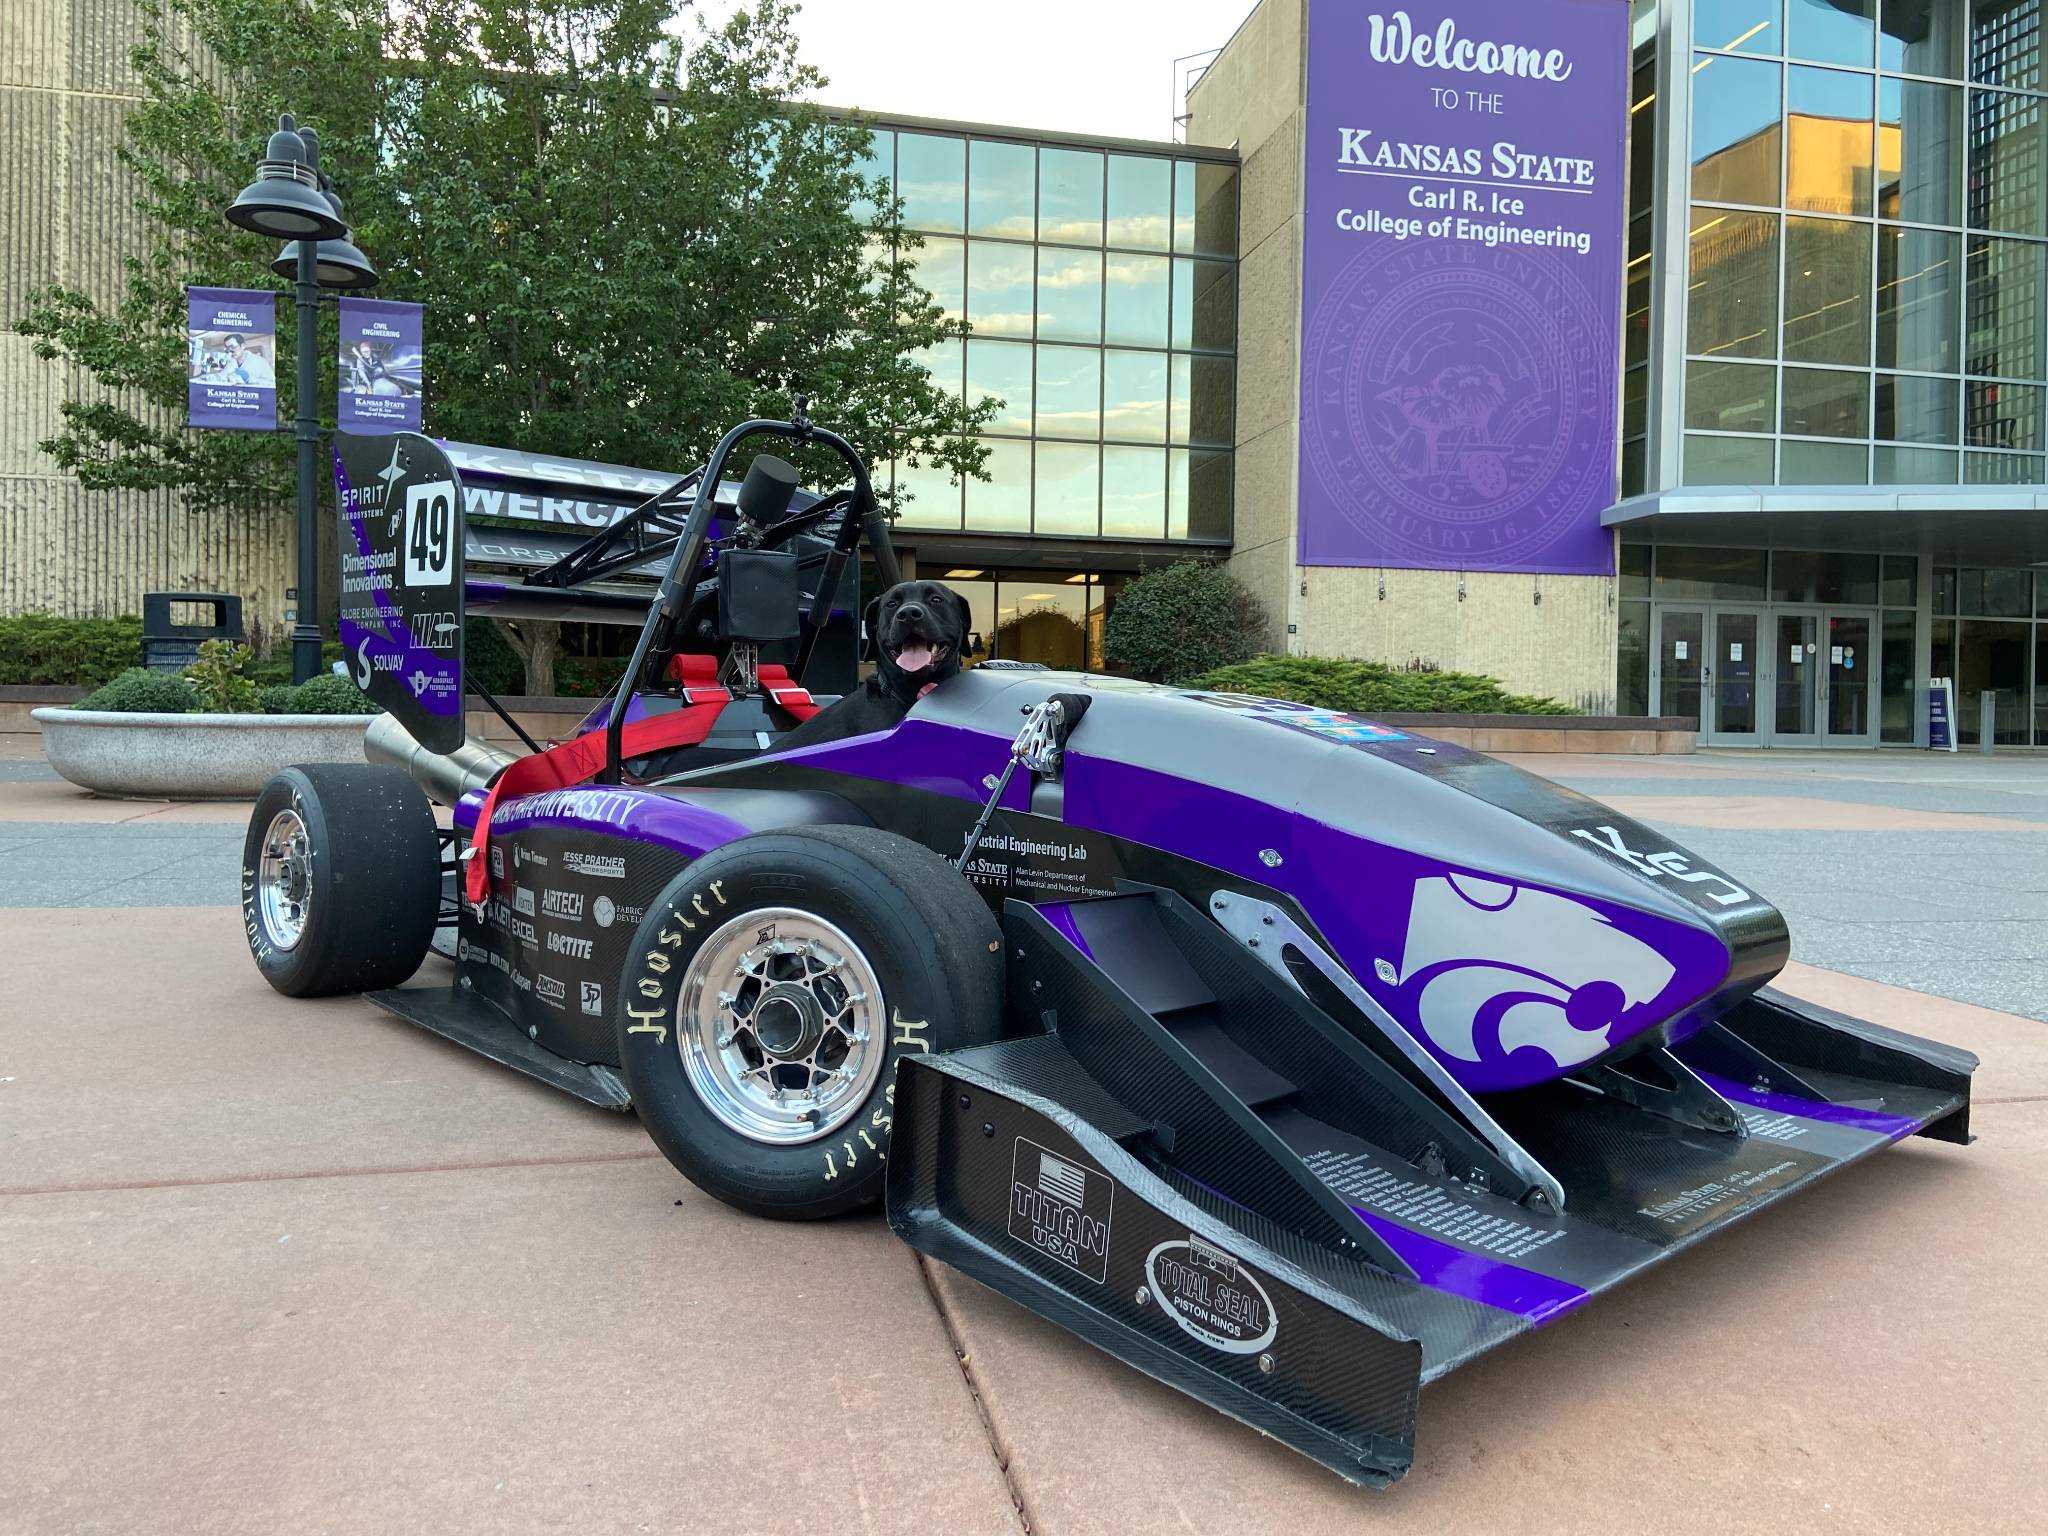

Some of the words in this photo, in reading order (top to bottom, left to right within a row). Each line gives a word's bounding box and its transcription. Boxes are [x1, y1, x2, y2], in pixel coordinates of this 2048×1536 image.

[1368, 11, 1572, 82] Welcome
[1431, 87, 1458, 110] TO
[1465, 91, 1503, 115] THE
[1338, 127, 1481, 176] KANSAS
[1492, 142, 1595, 186] STATE
[1408, 186, 1456, 211] Carl
[1463, 190, 1485, 213] R.
[1492, 192, 1525, 216] Ice
[1336, 208, 1422, 240] College
[1428, 216, 1452, 238] of
[1456, 218, 1591, 255] Engineering
[212, 318, 253, 328] ENGINEERING
[217, 311, 247, 320] CHEMICAL
[373, 322, 388, 330] CIVIL
[362, 328, 400, 338] ENGINEERING
[1323, 282, 1380, 406] KANSAS
[1384, 244, 1478, 283] STATE
[1493, 254, 1598, 420] UNIVERSITY
[341, 484, 384, 508] SPIRIT
[1337, 455, 1476, 550] FEBRUARY
[341, 508, 384, 521] AEROSYSTEMS
[410, 494, 449, 572] 49
[342, 546, 397, 573] Dimensional
[342, 571, 393, 593] Innovations
[341, 607, 360, 620] GLOBE
[361, 605, 404, 619] ENGINEERING
[374, 654, 404, 671] SOLVAY
[535, 789, 646, 825] UNIVERSITY
[964, 831, 1008, 850] Iustrial
[1009, 836, 1067, 861] Engineering
[1068, 843, 1087, 860] Lab
[563, 851, 584, 864] JESSE
[584, 854, 626, 868] PRATHER
[978, 858, 1008, 875] STATE
[966, 875, 1008, 887] ERSITY
[1015, 866, 1028, 875] Alan
[1044, 870, 1078, 882] Department
[1079, 874, 1086, 882] of
[1047, 882, 1058, 890] and
[1058, 883, 1080, 893] Nuclear
[541, 888, 585, 916] AIRTECH
[616, 905, 643, 916] FABRIC
[511, 918, 539, 944] EXCEL
[546, 931, 594, 960] LOCTITE
[537, 975, 565, 998] AMSOIL
[1014, 1181, 1106, 1256] TITAN
[1032, 1225, 1079, 1265] USA
[1159, 1256, 1211, 1307] TOTAL
[1214, 1284, 1264, 1332] SEAL
[1173, 1295, 1209, 1321] PISTON
[1210, 1313, 1241, 1337] RINGS
